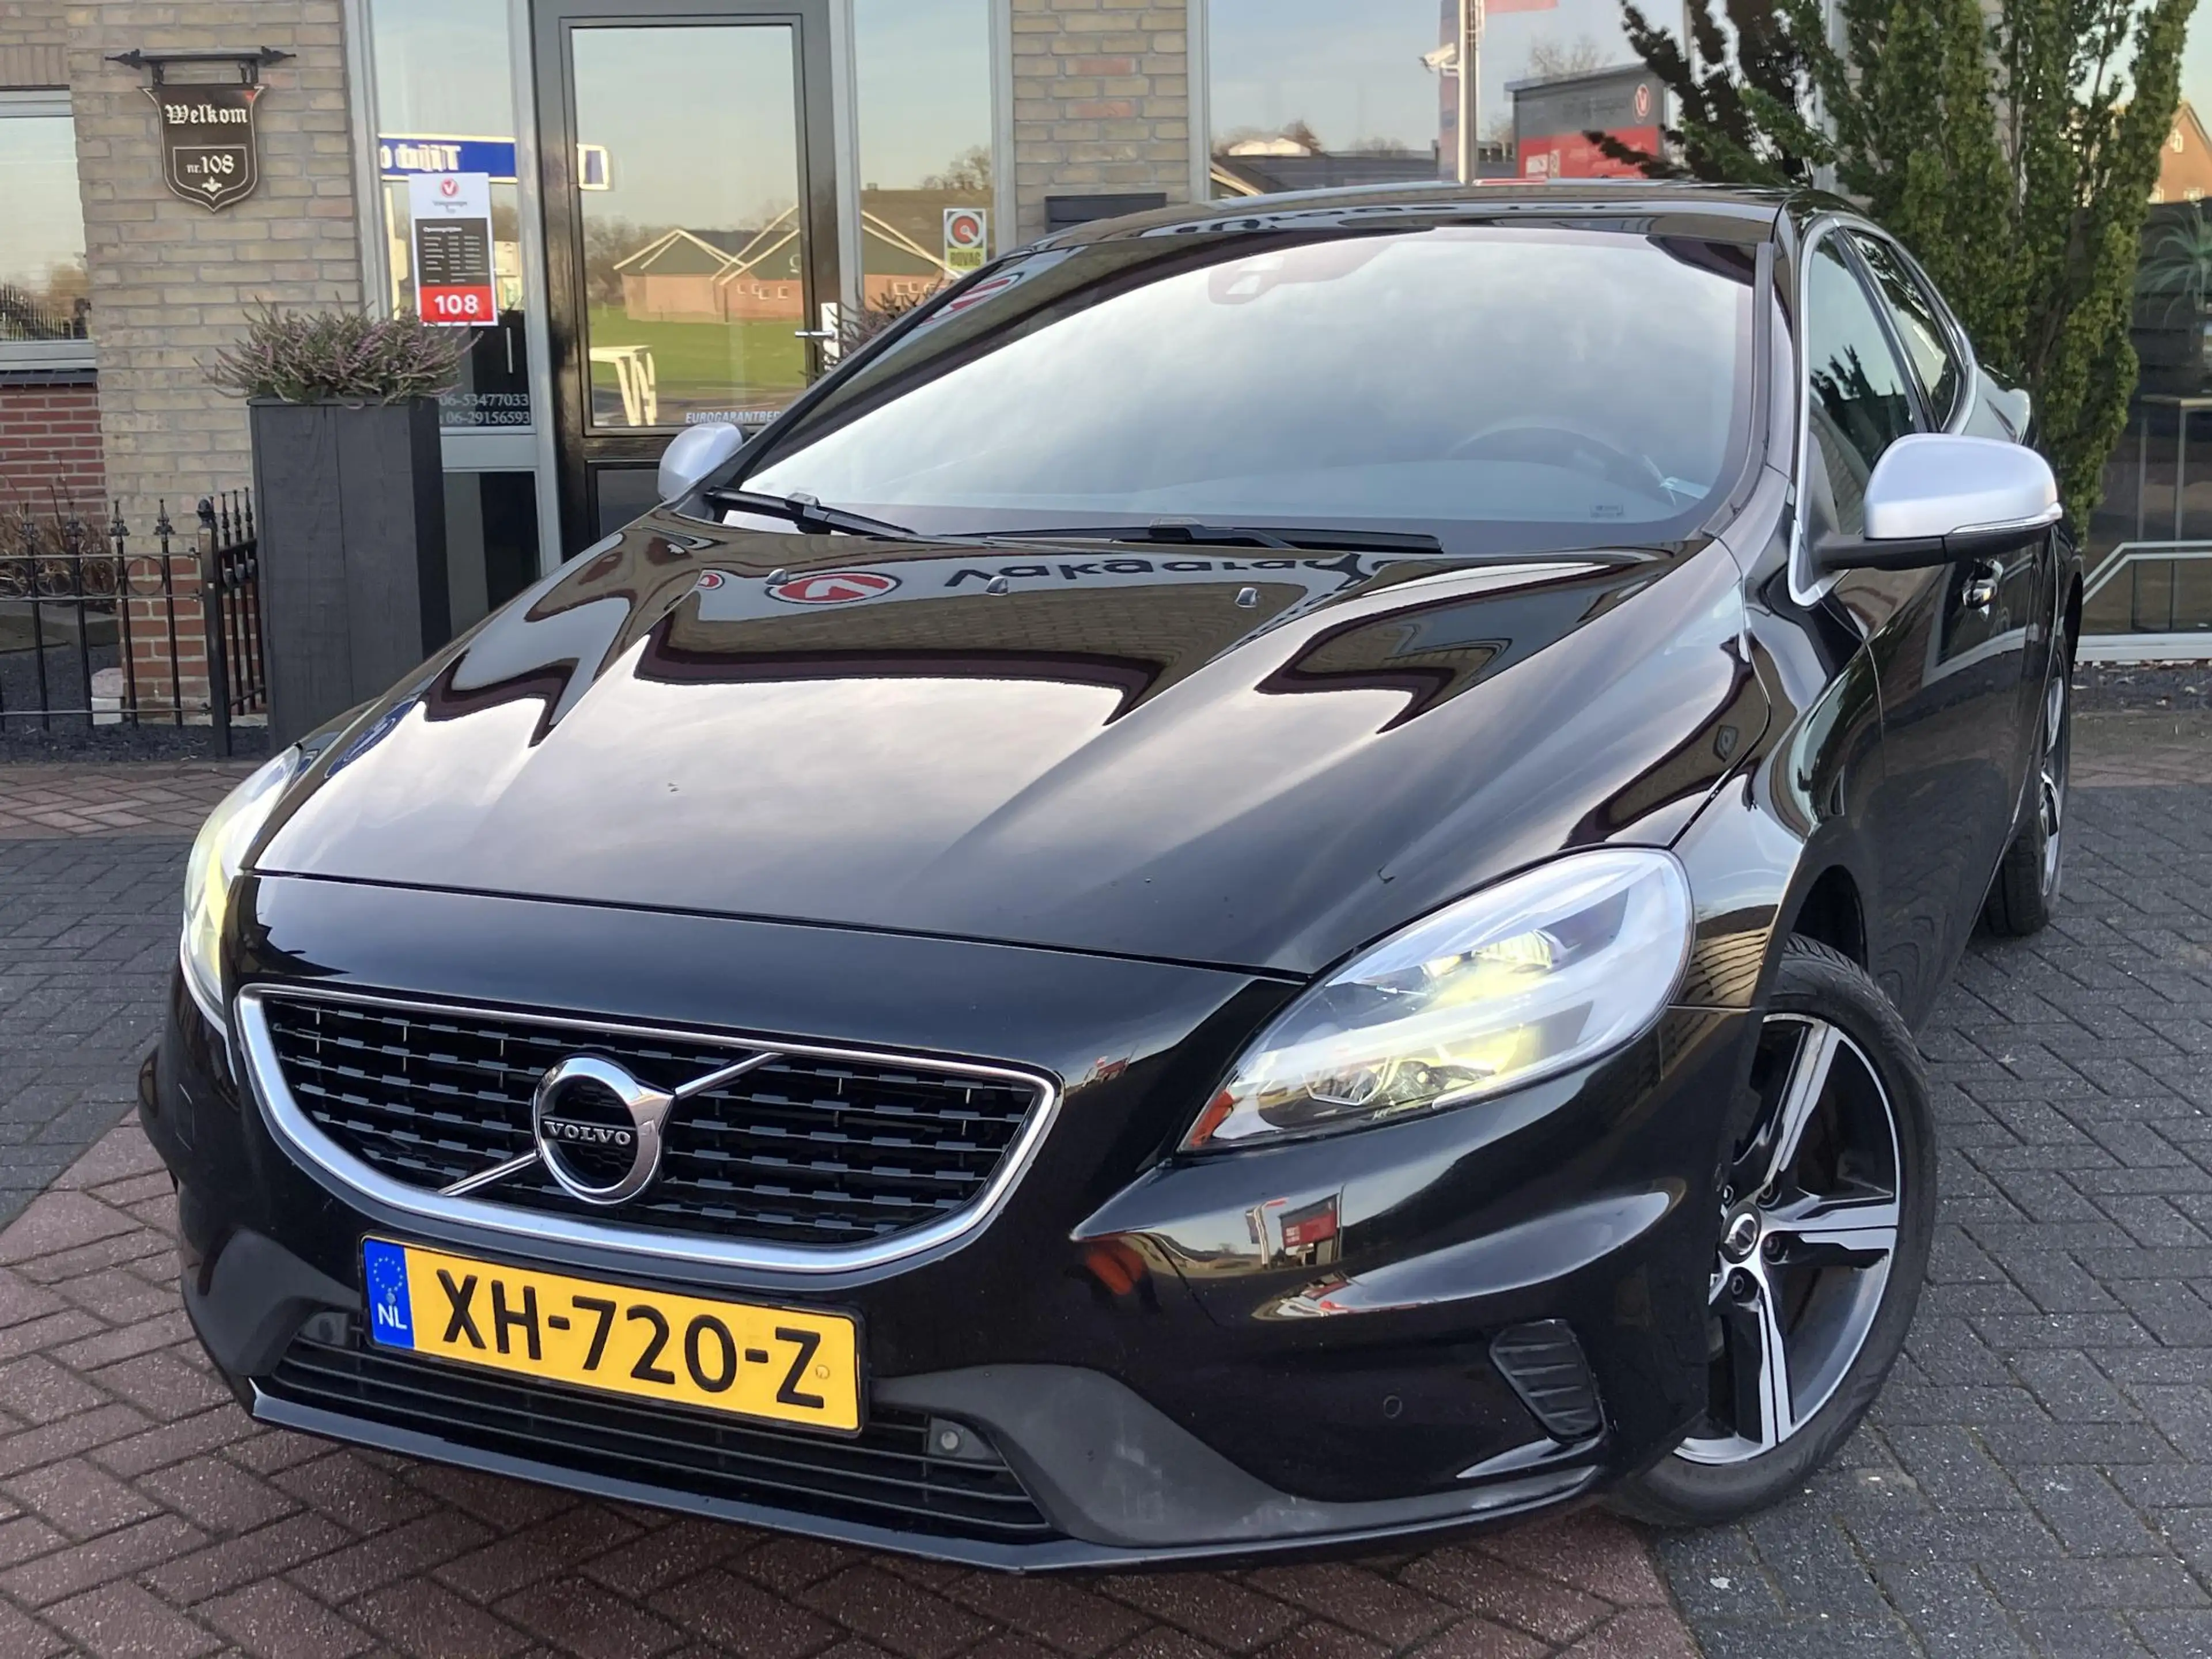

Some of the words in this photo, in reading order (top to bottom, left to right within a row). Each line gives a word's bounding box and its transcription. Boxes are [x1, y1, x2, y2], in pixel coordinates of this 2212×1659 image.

[165, 104, 248, 124] Welkom
[434, 294, 478, 315] 108
[439, 393, 529, 407] 06-53477033
[446, 411, 531, 425] 06-29156593
[544, 1121, 631, 1145] VOLVO
[378, 1305, 407, 1330] NL
[436, 1269, 824, 1410] XH-720-Z
